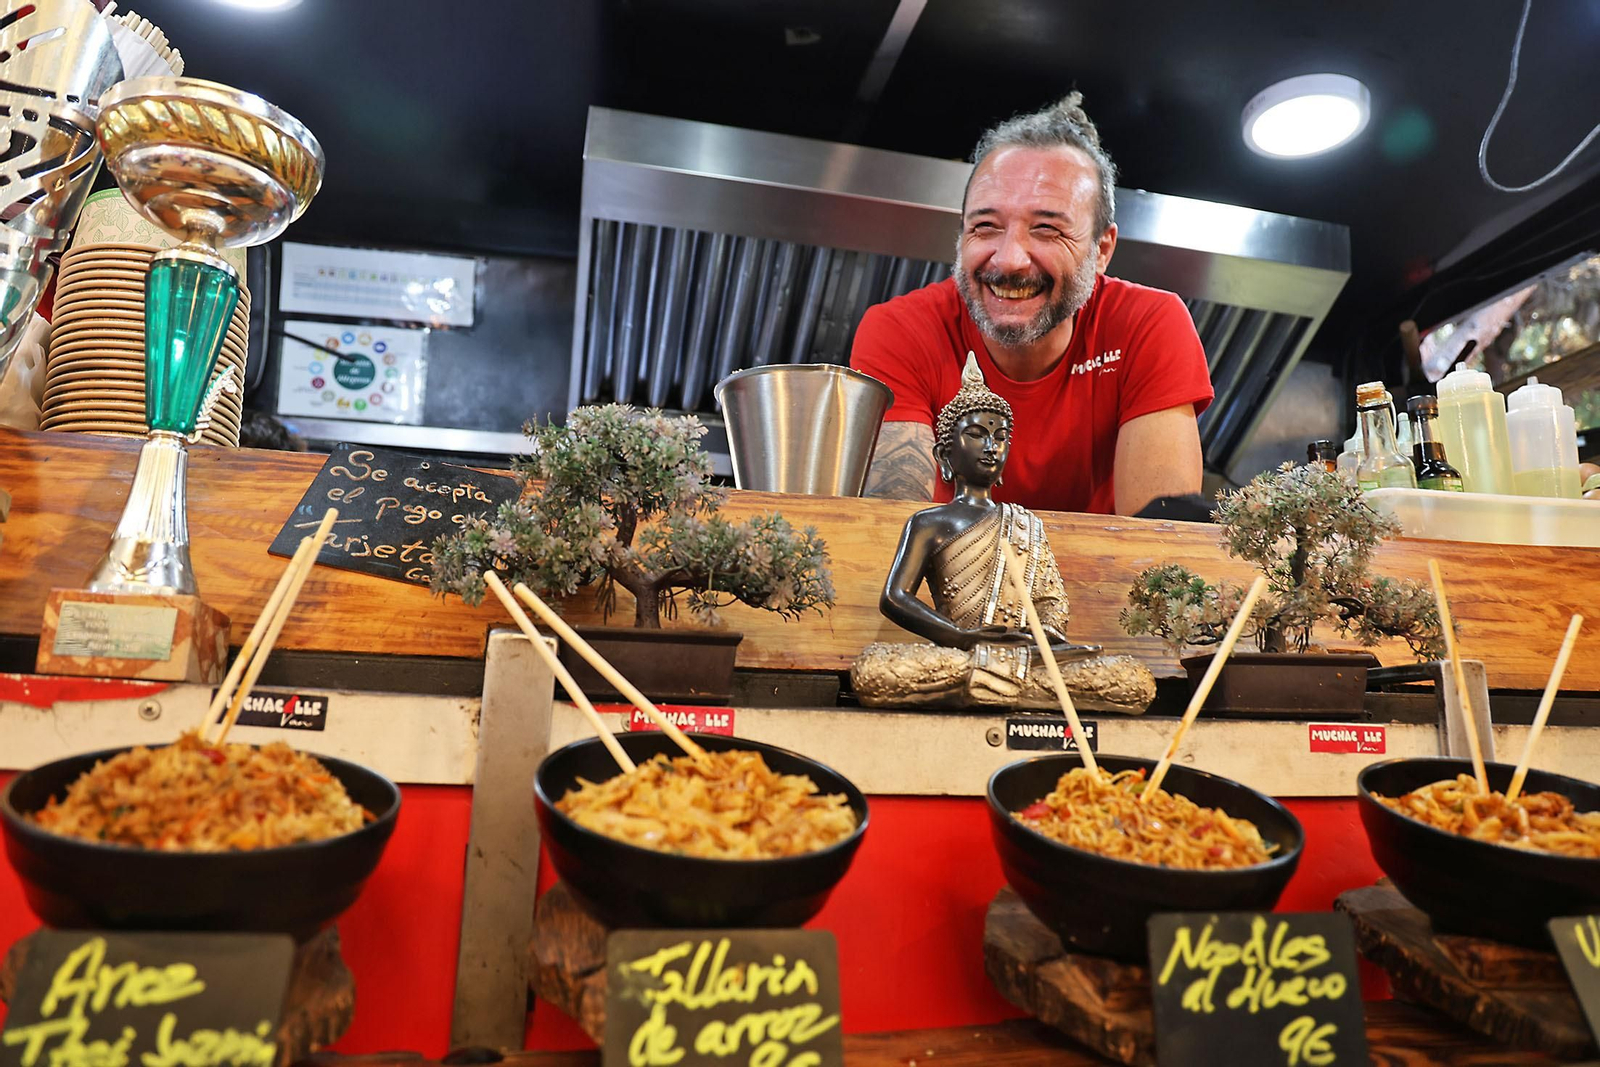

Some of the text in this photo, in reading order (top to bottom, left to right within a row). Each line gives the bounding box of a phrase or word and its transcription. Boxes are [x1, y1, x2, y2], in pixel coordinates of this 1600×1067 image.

[327, 486, 365, 504] el
[330, 450, 492, 504] Se acepta
[1158, 916, 1331, 985] Noodles
[628, 1003, 840, 1067] de arroz
